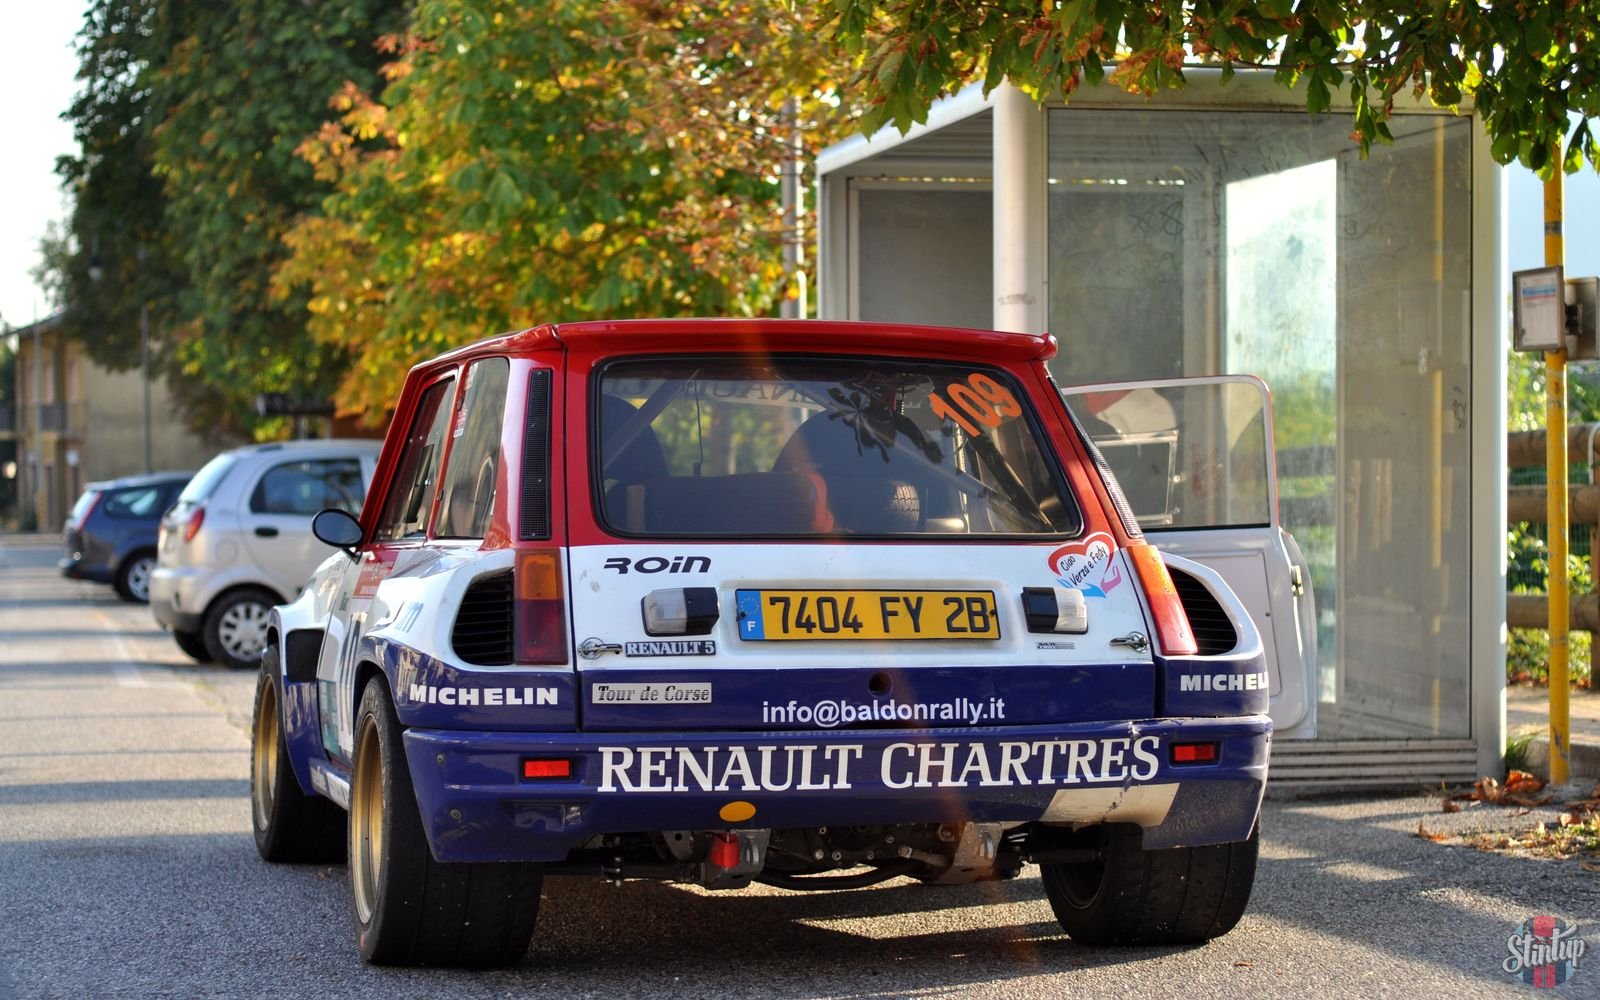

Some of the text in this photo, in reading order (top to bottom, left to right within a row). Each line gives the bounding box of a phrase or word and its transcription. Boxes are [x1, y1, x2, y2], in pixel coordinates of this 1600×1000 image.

[928, 373, 1022, 437] 109
[1060, 556, 1076, 571] Ciao
[1069, 545, 1108, 586] Verza e Fedy
[747, 621, 756, 632] F
[769, 596, 991, 634] 7404 FY 2B
[627, 641, 715, 655] RENAULT 5
[409, 684, 558, 706] MICHELIN
[598, 686, 710, 701] Tour de Corse
[763, 698, 1005, 727] info@baldonrally.it
[597, 736, 1160, 793] RENAULT CHARTRES
